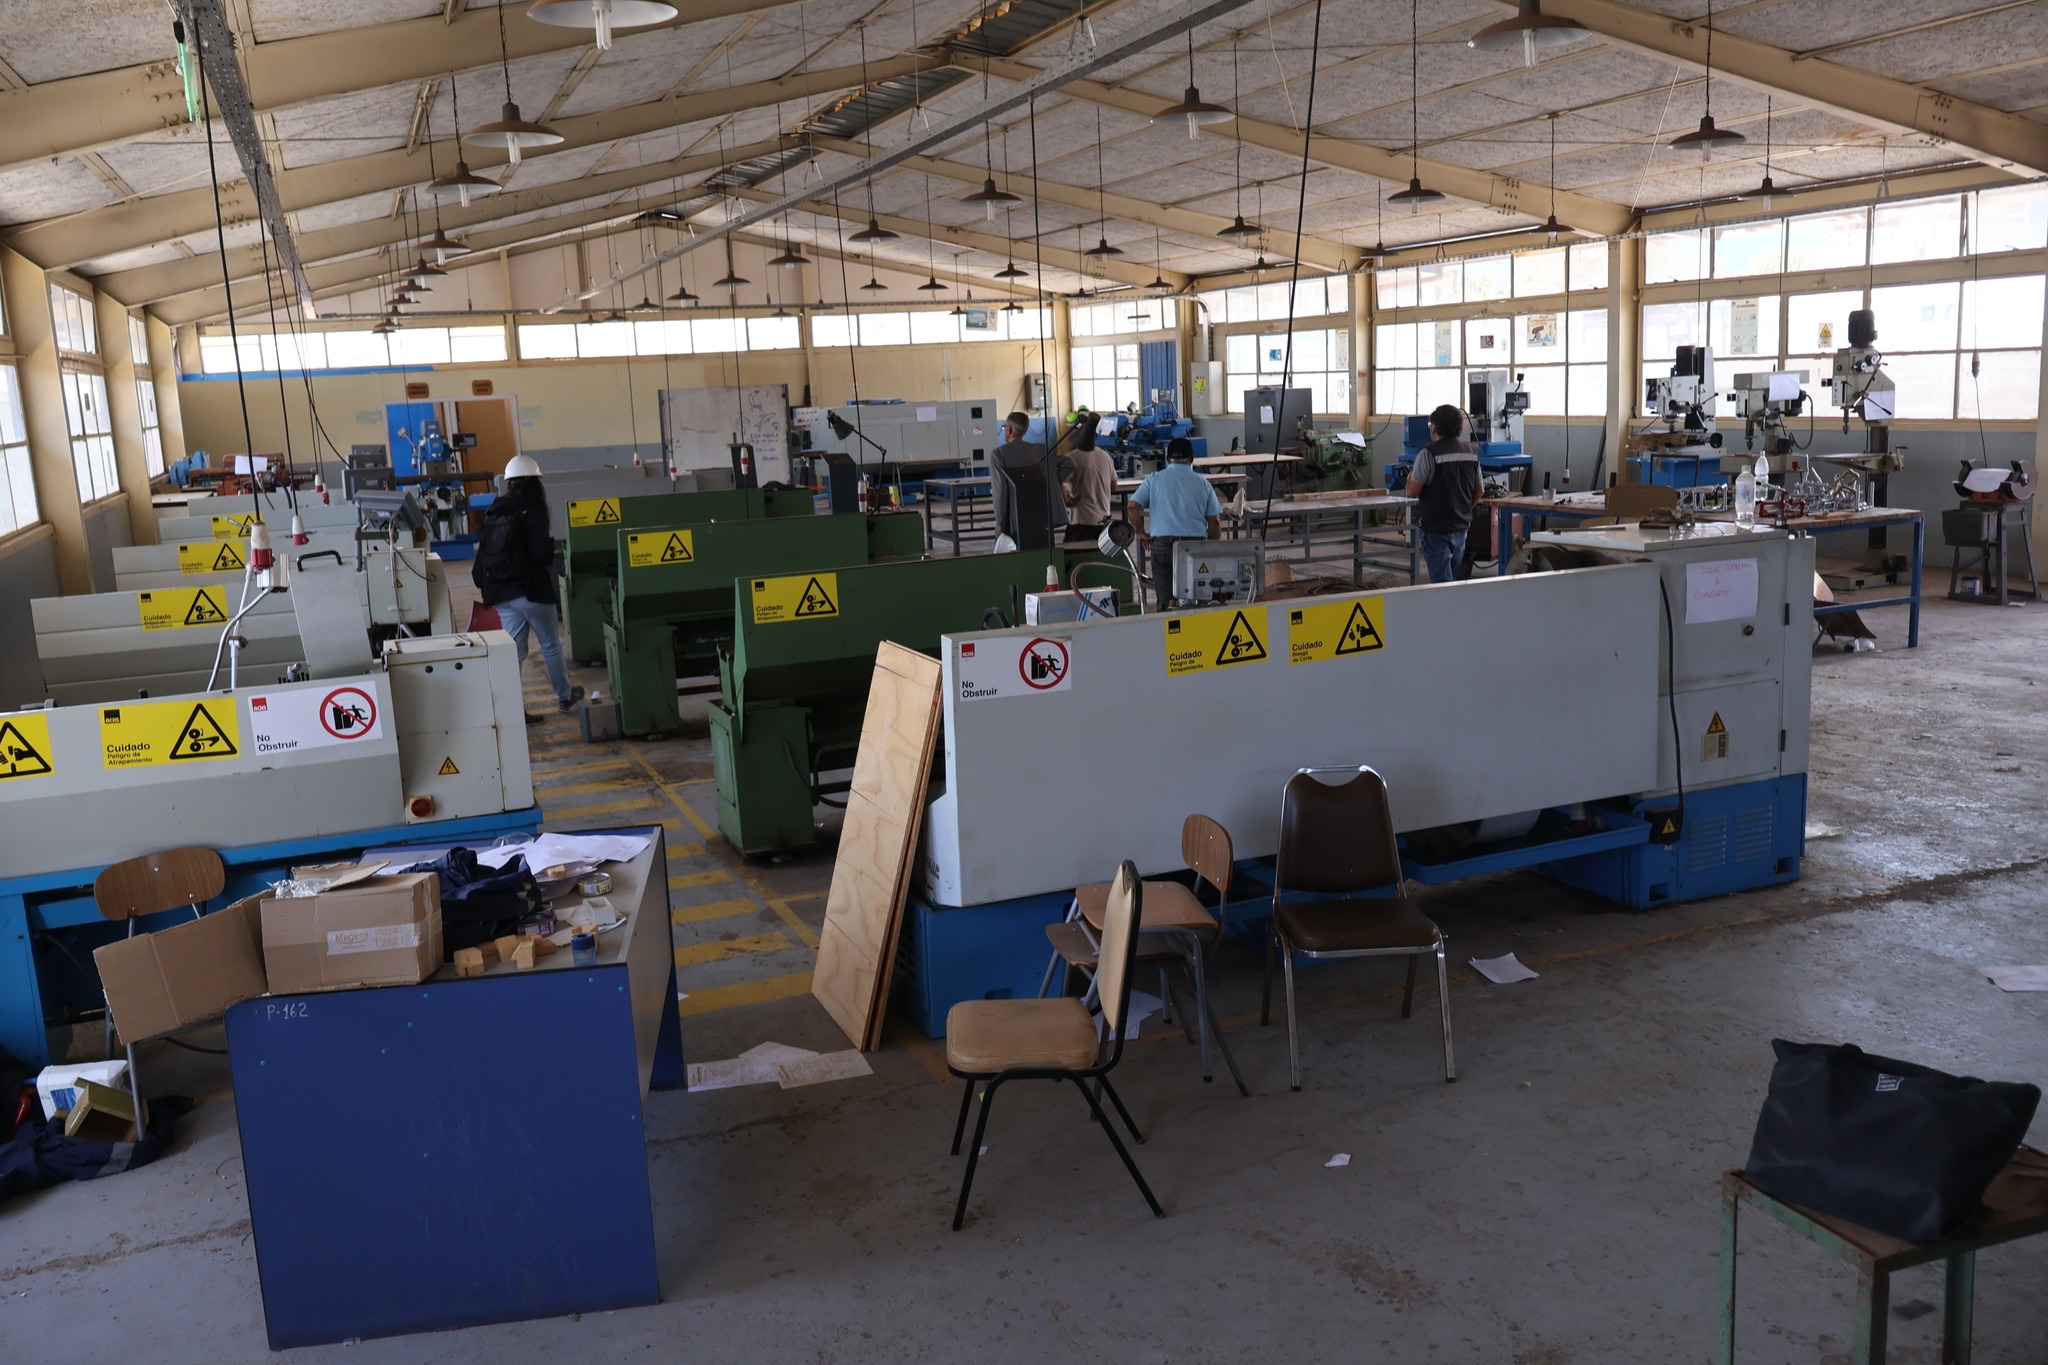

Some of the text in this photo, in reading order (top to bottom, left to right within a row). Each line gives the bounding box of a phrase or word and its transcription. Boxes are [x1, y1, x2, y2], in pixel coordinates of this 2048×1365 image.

[756, 604, 784, 612] Cuidado
[143, 613, 172, 621] Cuidado
[1292, 640, 1323, 651] Cuidado
[1169, 650, 1203, 661] Cuidado
[1170, 660, 1188, 668] Peligro
[1170, 663, 1204, 673] Atrapamiento
[961, 680, 974, 689] No
[962, 687, 998, 698] Obstruir
[256, 734, 271, 743] No
[106, 742, 151, 753] Cuidado
[258, 740, 299, 752] Obstruir
[107, 752, 130, 761] Peligro
[108, 757, 153, 766] Atrapamiento
